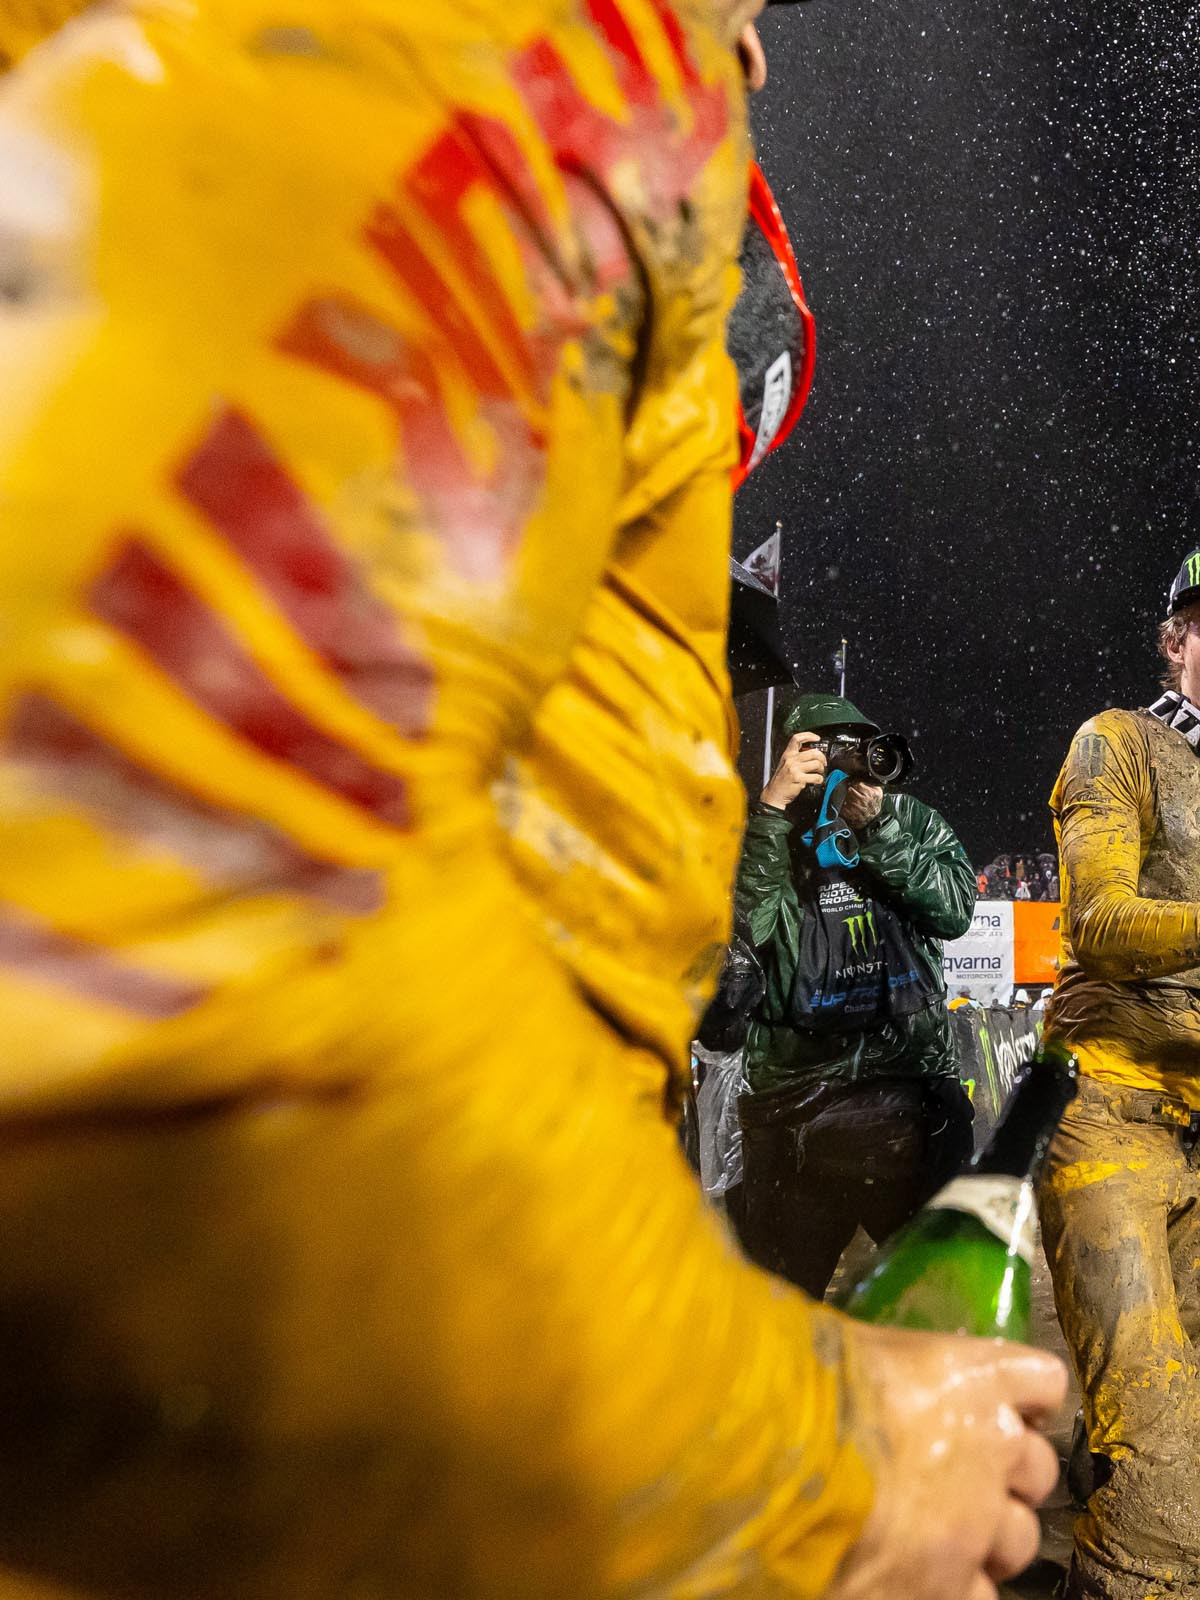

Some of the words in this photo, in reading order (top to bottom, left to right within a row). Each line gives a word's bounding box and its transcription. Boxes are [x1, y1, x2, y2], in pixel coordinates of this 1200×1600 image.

[818, 893, 859, 906] CROSS
[819, 887, 855, 899] MOTO
[943, 956, 1001, 973] qvarna
